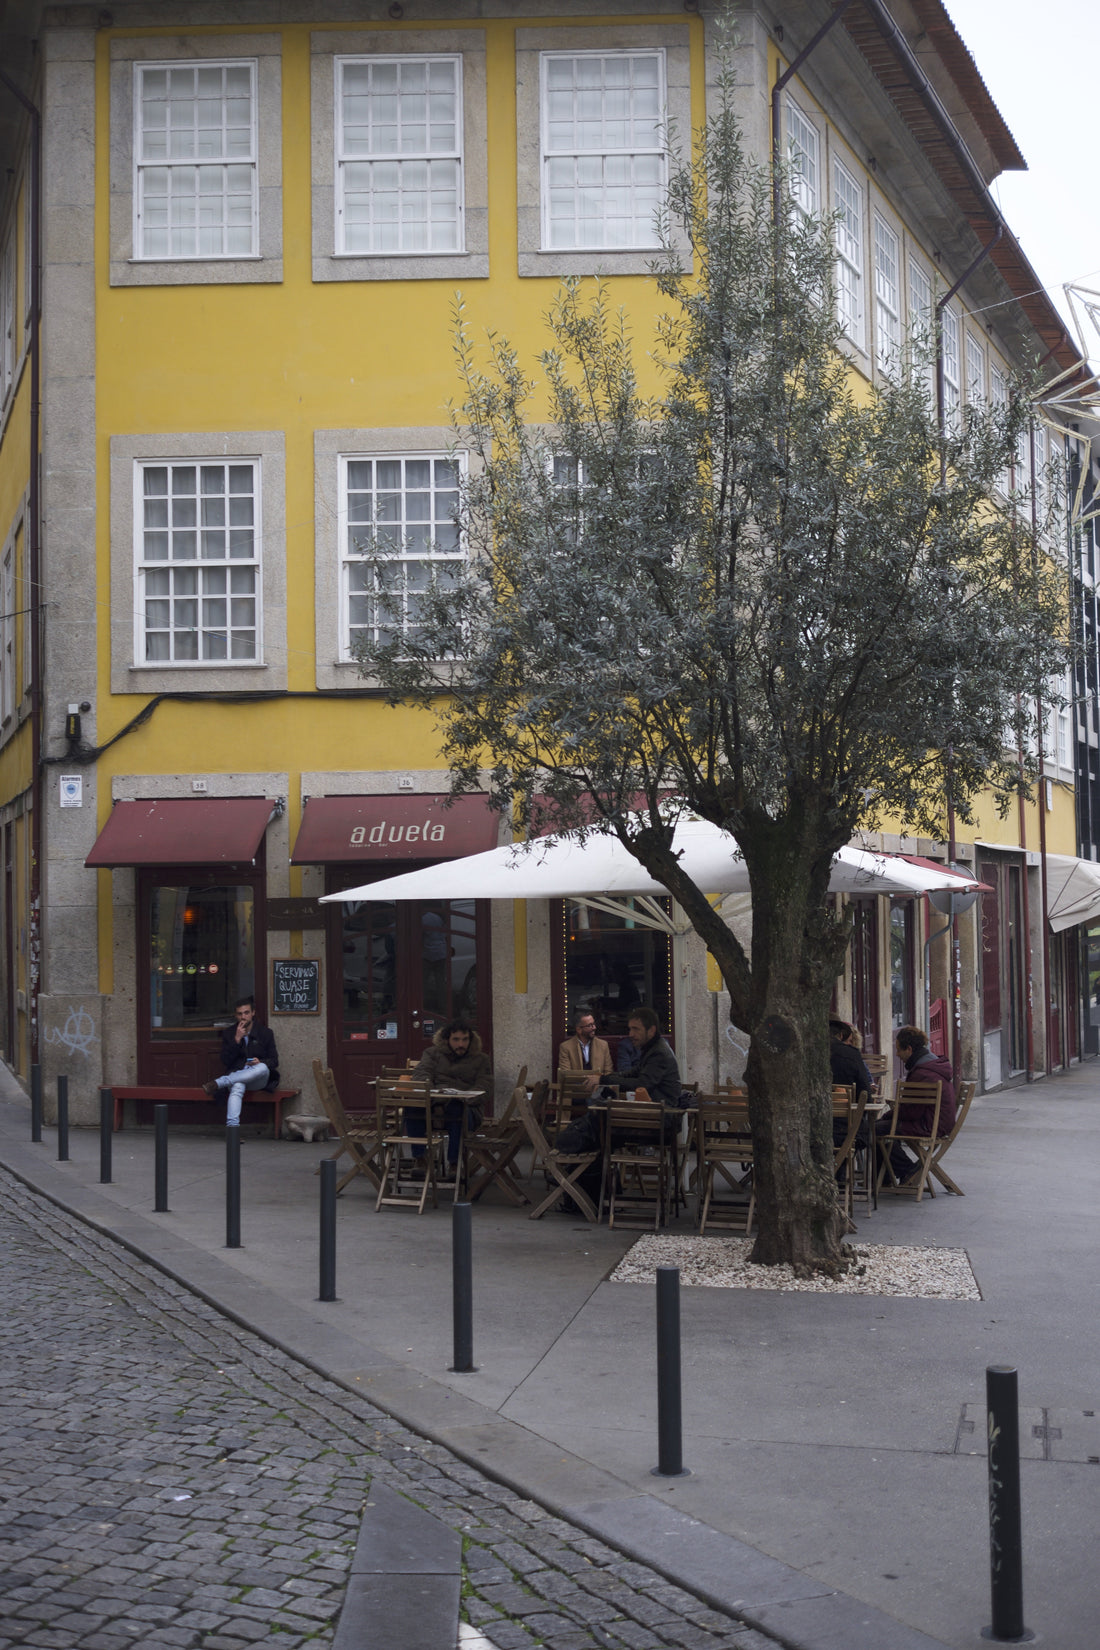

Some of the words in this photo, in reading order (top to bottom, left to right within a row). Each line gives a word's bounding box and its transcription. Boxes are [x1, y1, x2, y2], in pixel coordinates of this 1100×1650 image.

[350, 820, 446, 844] aduela
[279, 979, 310, 992] QUASE
[280, 993, 307, 1003] TUDO
